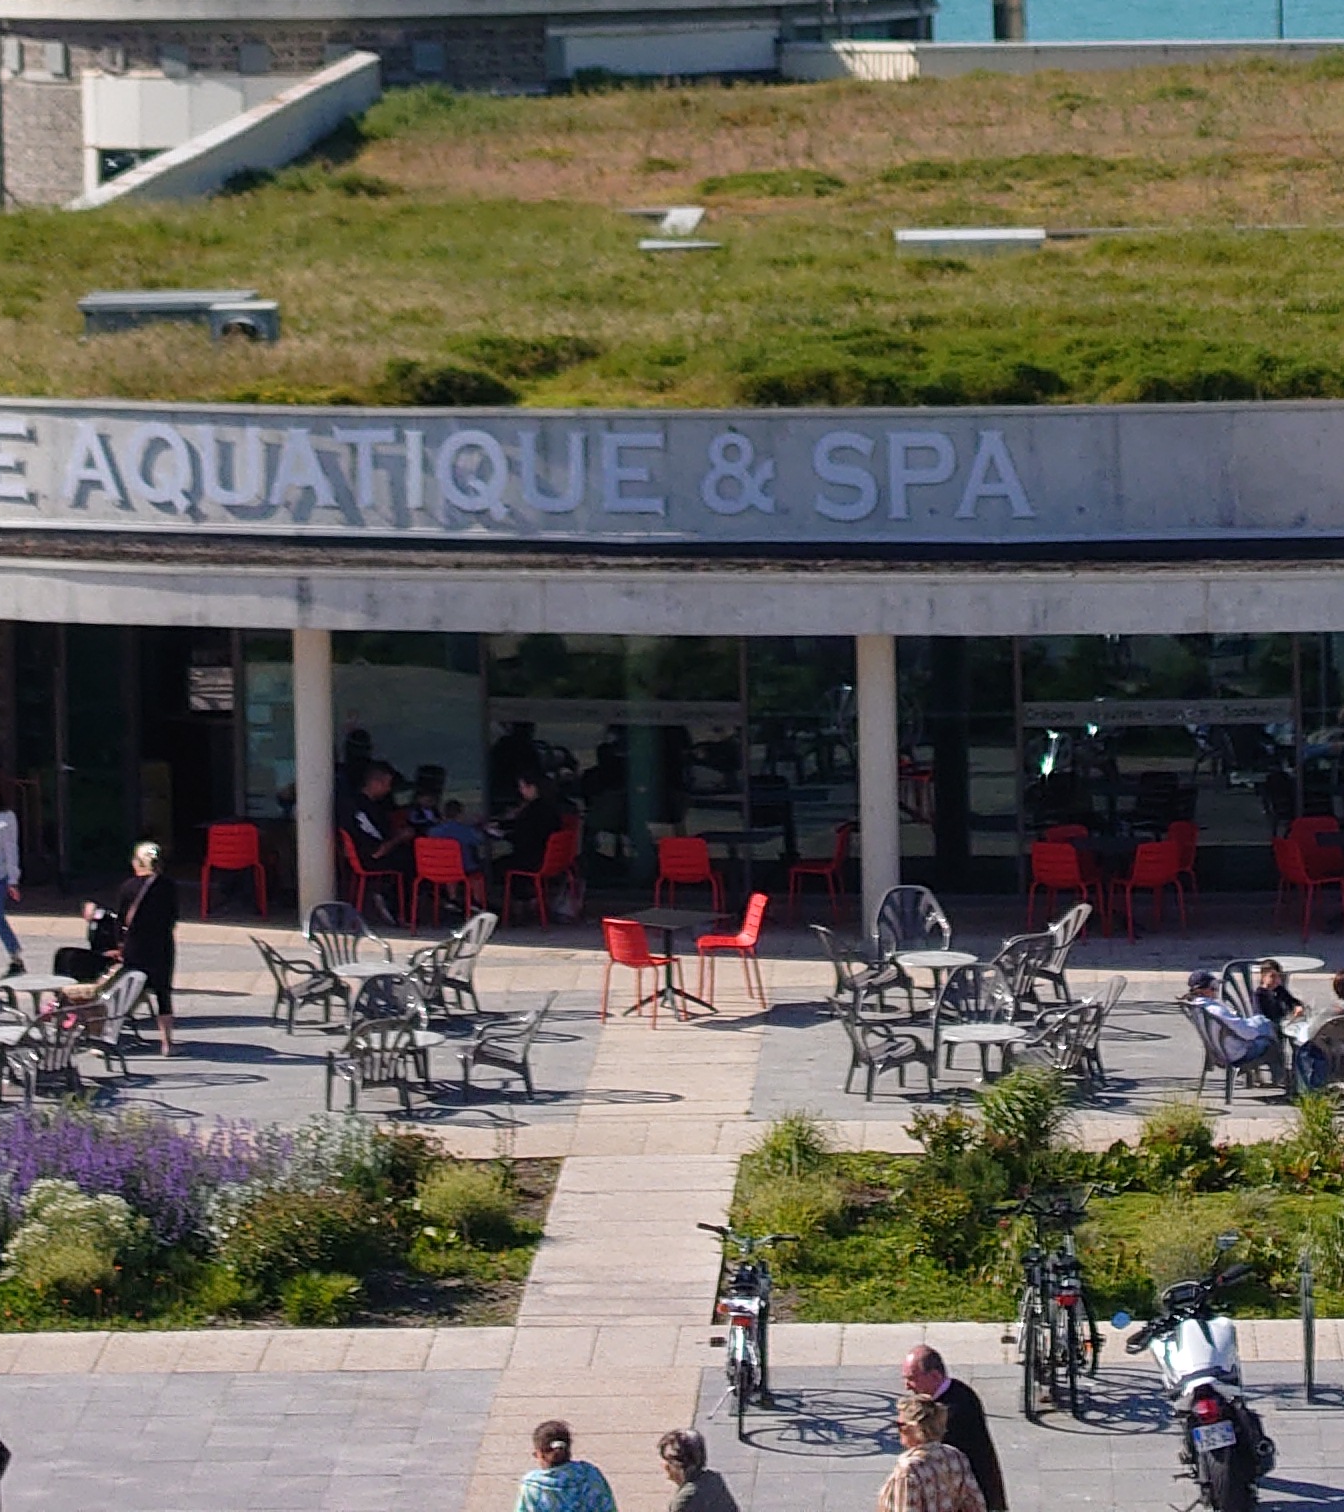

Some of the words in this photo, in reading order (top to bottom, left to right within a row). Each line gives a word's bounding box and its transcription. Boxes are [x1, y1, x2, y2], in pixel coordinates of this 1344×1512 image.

[65, 419, 664, 519] AQUATIQUE
[700, 432, 775, 516] &
[813, 429, 1036, 521] SPA
